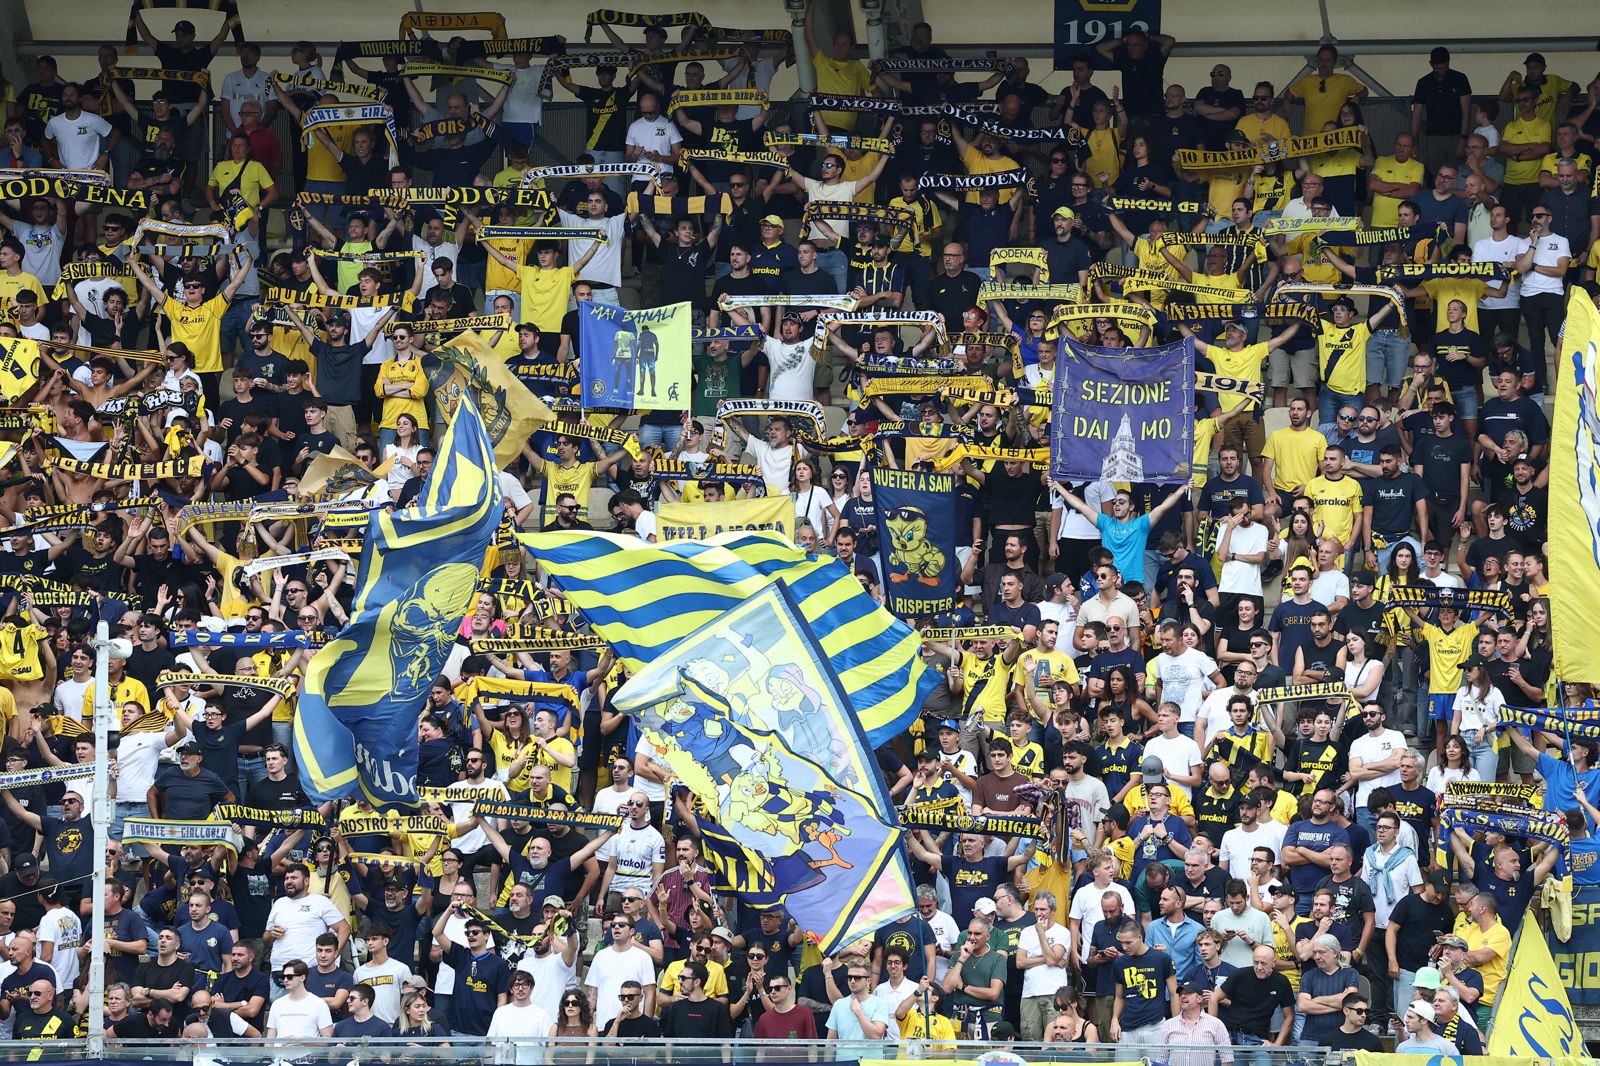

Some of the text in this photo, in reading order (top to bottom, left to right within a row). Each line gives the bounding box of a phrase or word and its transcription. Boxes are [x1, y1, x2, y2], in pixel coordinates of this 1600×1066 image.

[360, 41, 422, 54] MODENA FC
[529, 38, 542, 52] FC
[886, 58, 992, 69] WORKING CLASS
[982, 119, 1066, 139] MODENA
[1291, 137, 1320, 151] NEI
[85, 183, 149, 209] ENA
[1112, 198, 1199, 213] ED MODNA
[72, 264, 97, 278] SOLO
[1403, 262, 1494, 276] ED MODNA
[590, 306, 679, 322] MAI BANALI
[2, 339, 20, 372] kerakoll
[1081, 380, 1173, 405] SEZIONE
[562, 423, 609, 441] MODENA
[1072, 416, 1172, 441] DAI MO
[873, 468, 953, 493] NUETER A SAM
[896, 597, 953, 615] RISPETER
[174, 629, 309, 646] MODENA
[974, 627, 1006, 639] 1912
[13, 629, 25, 658] 4
[220, 805, 270, 822] VECCHIE
[341, 818, 388, 834] NOSTRO
